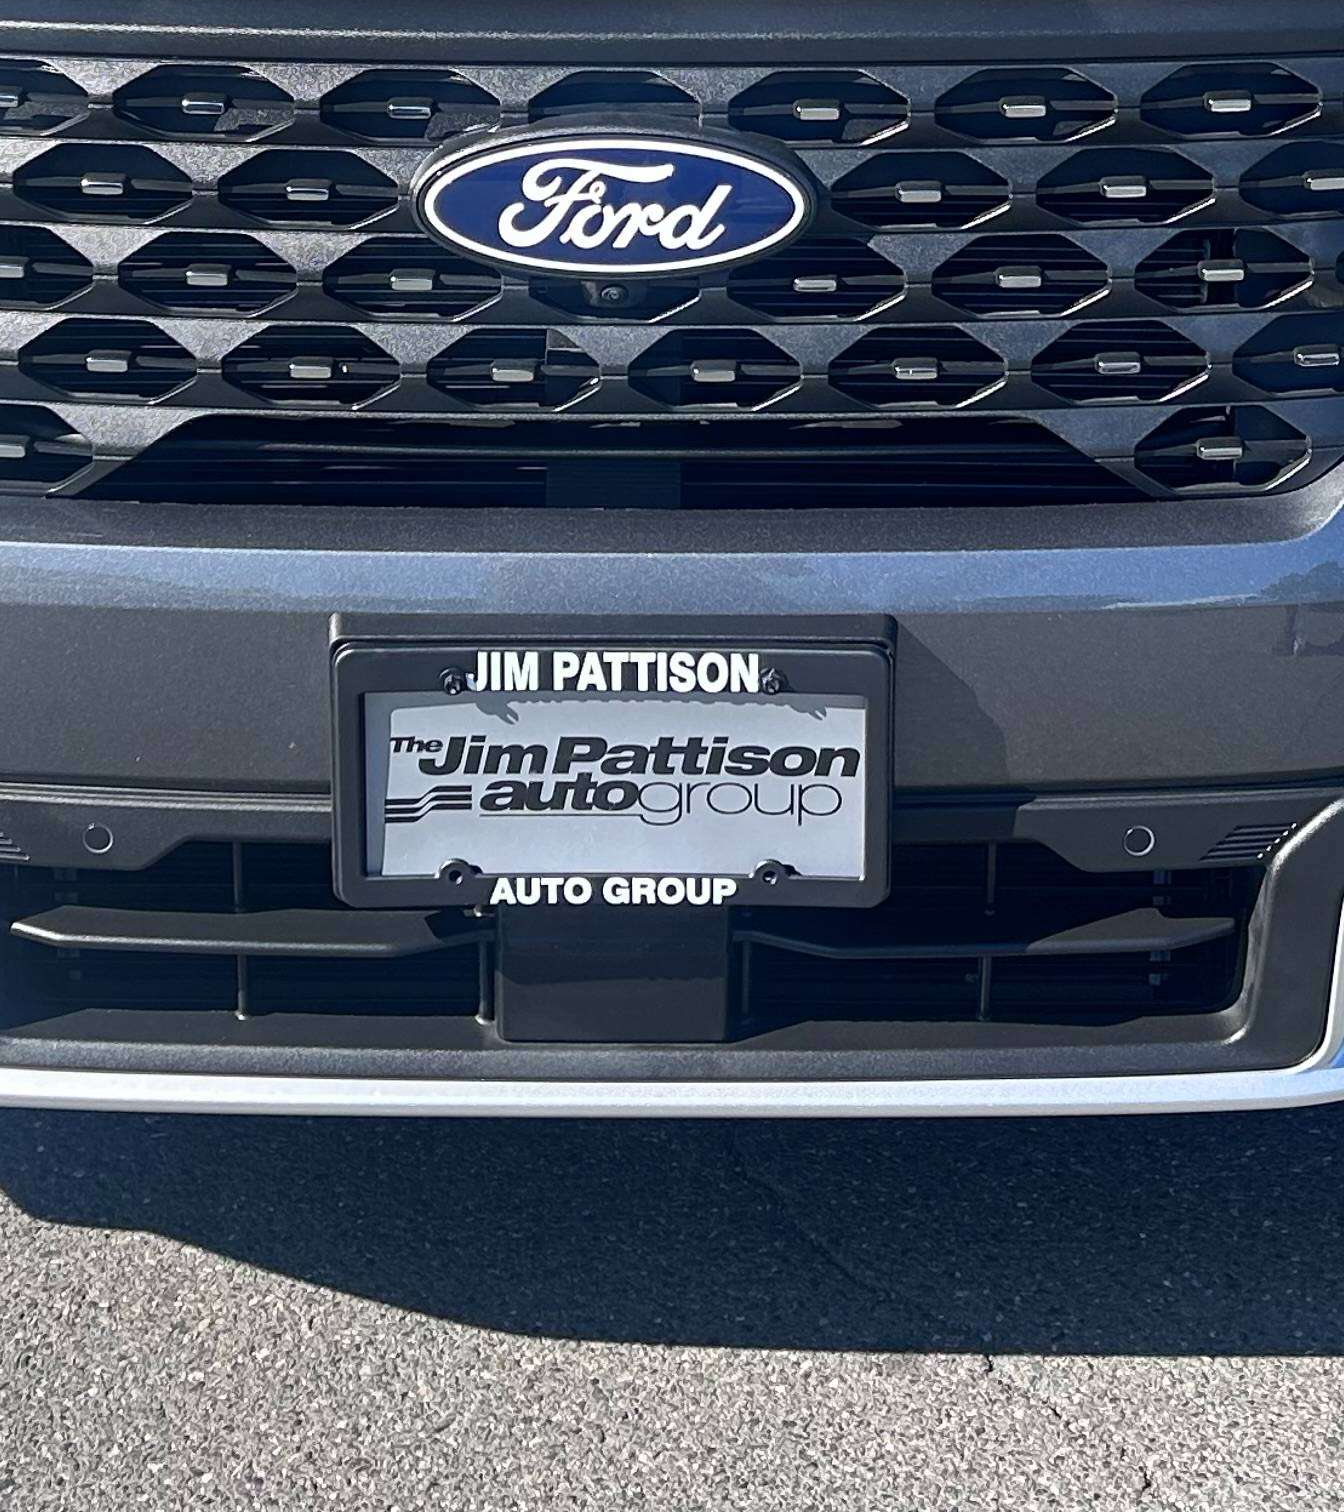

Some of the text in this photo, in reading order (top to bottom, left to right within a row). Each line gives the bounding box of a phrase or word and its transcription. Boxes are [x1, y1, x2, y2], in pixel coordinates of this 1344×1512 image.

[498, 158, 733, 251] Ford
[465, 651, 759, 693] JIM PATTISON
[390, 735, 444, 754] The
[489, 876, 737, 905] AUTO GROUP
